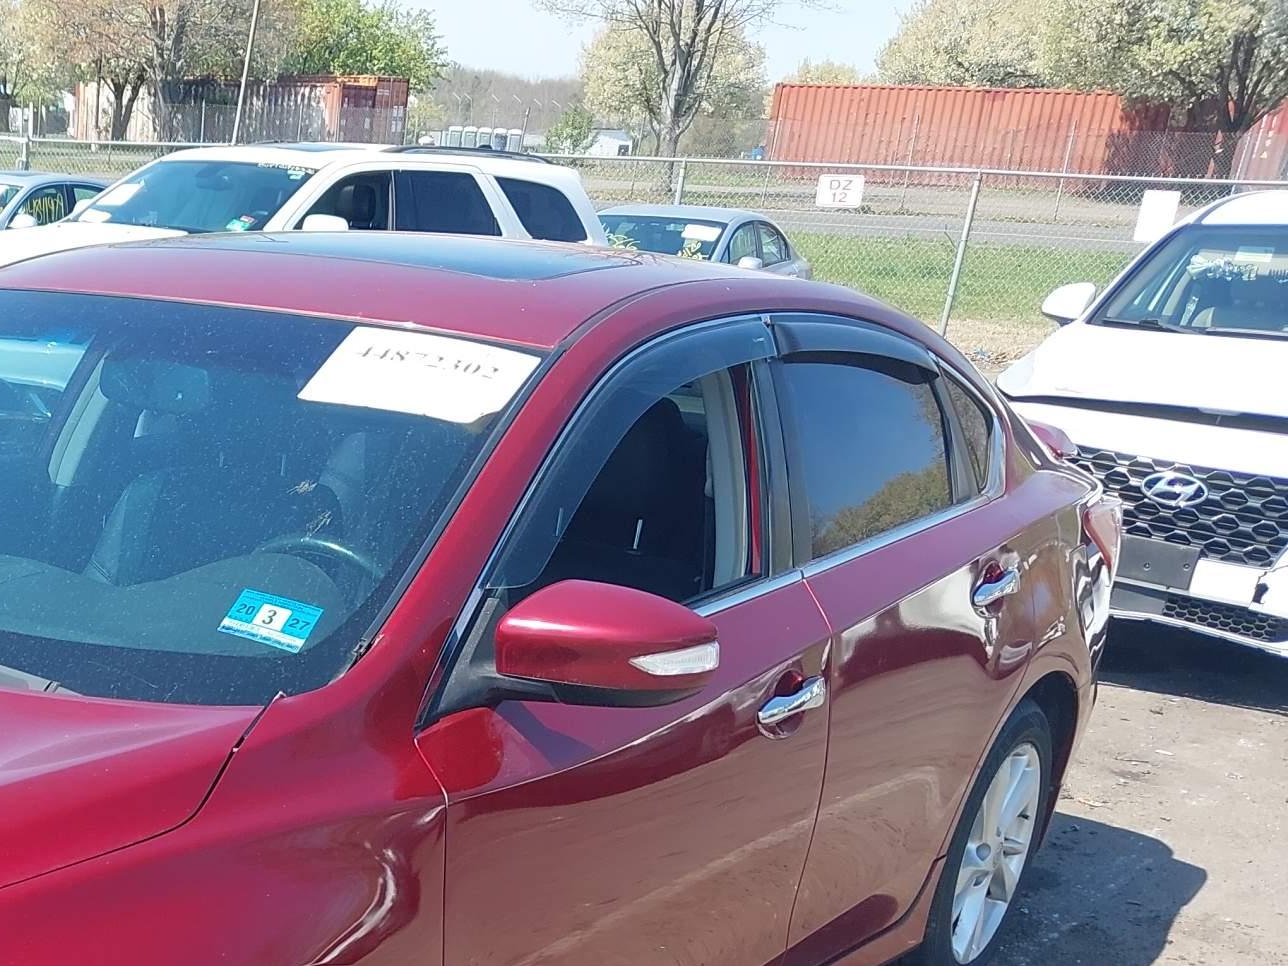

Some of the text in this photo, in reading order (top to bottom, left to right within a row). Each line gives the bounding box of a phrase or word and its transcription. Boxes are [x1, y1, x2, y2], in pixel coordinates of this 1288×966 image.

[830, 180, 853, 190] DZ
[832, 192, 848, 202] 12
[236, 603, 311, 630] 20 3 27
